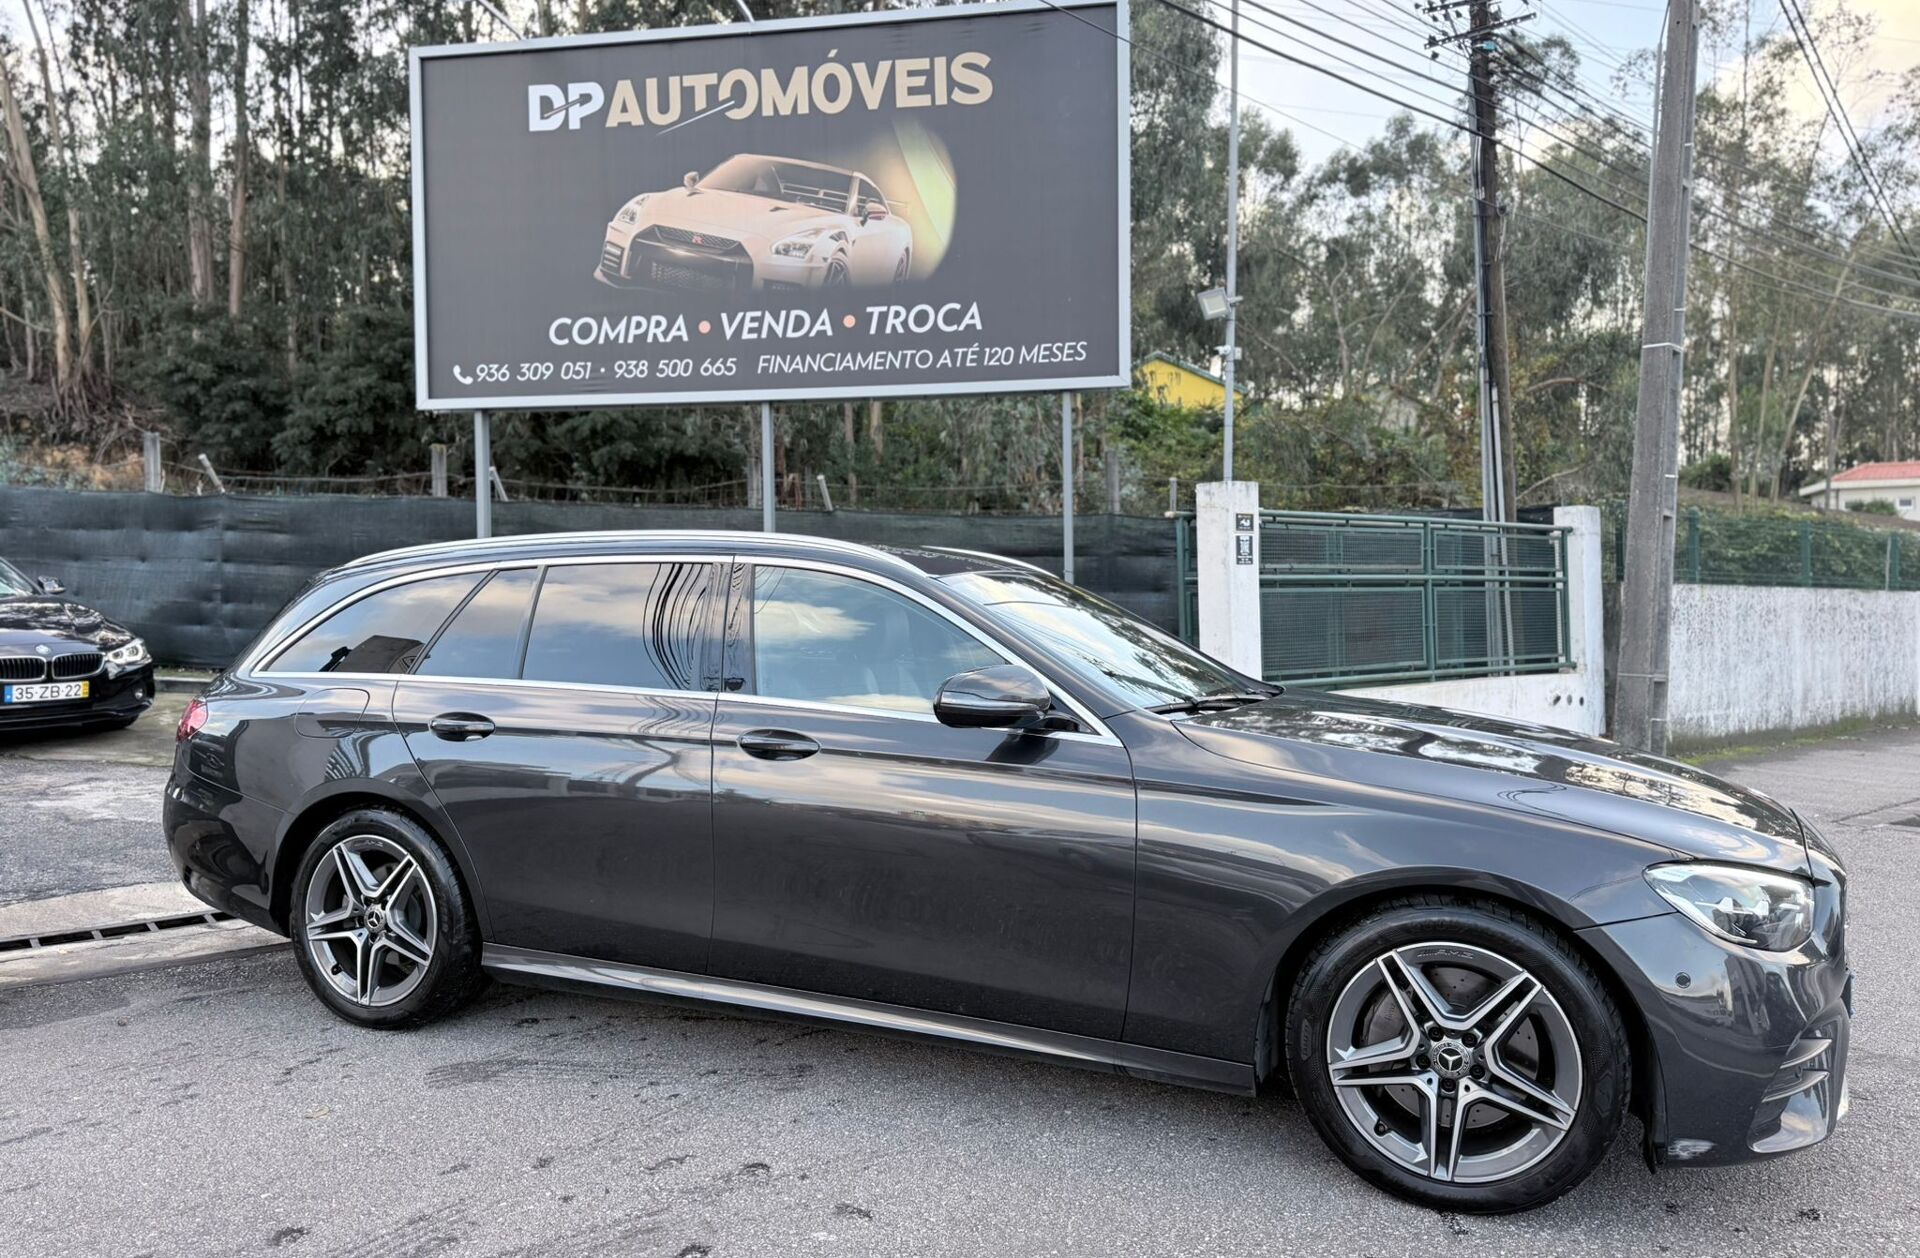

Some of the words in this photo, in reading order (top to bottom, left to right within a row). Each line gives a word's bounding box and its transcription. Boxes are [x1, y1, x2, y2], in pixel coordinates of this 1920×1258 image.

[549, 314, 689, 346] COMPRA
[720, 308, 833, 340] VENDA
[865, 301, 983, 335] TROCA
[476, 364, 510, 382] 936
[516, 362, 554, 381] 309
[560, 361, 592, 380] 051
[614, 360, 648, 379] 938
[656, 358, 693, 377] 500
[700, 358, 737, 376] 665
[757, 349, 933, 374] FINANCIAMENTO
[936, 343, 980, 369] ATÉ
[983, 347, 1014, 366] 120
[1019, 341, 1087, 365] MESES
